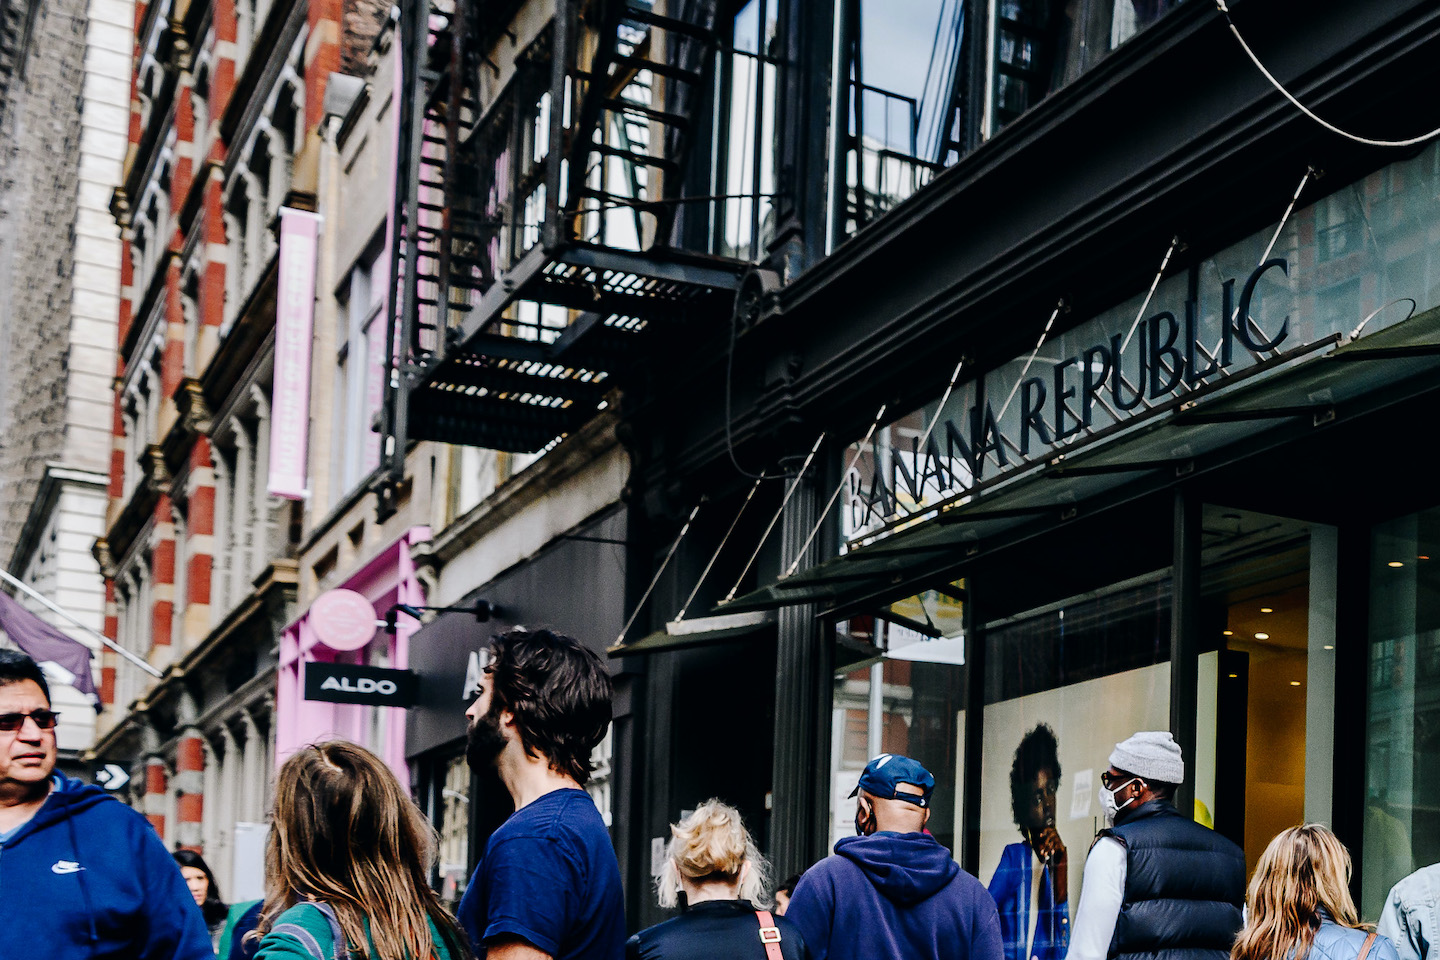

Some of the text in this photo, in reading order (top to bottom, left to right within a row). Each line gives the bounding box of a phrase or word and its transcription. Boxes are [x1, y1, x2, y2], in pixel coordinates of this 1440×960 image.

[846, 257, 1290, 534] BANANA REPUBLIC
[320, 676, 397, 695] ALDO
